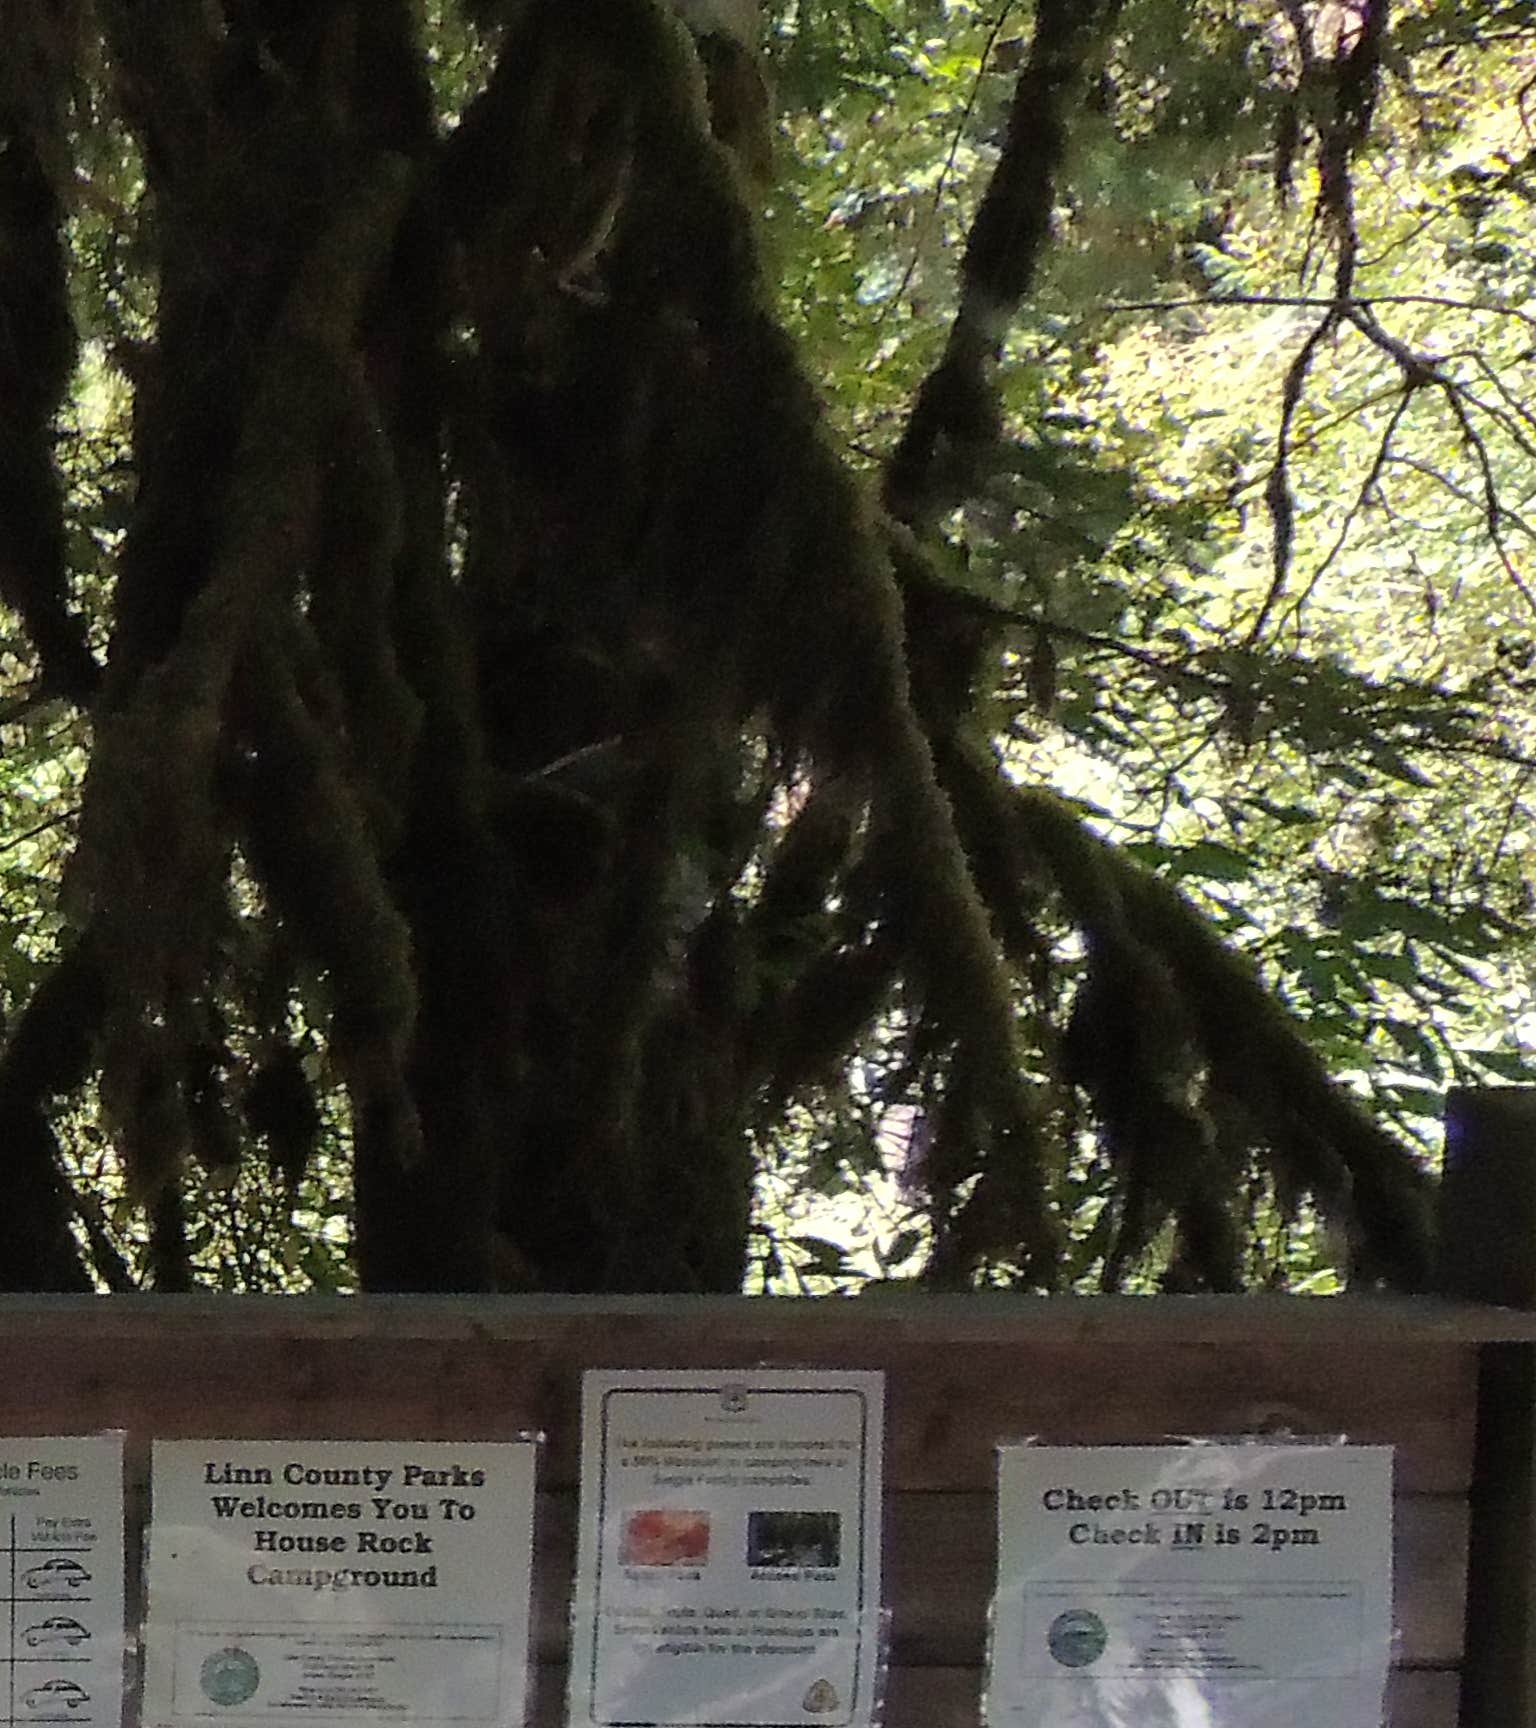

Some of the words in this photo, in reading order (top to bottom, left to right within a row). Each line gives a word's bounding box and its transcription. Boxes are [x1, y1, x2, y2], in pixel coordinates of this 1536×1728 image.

[28, 1463, 79, 1481] Fees
[204, 1463, 272, 1486] Linn
[284, 1464, 392, 1491] County
[404, 1465, 485, 1488] Parks
[210, 1497, 362, 1519] Welcomes
[371, 1499, 428, 1520] You
[440, 1500, 475, 1521] To
[1043, 1488, 1138, 1512] Check
[1151, 1490, 1212, 1513] OUT
[1222, 1488, 1248, 1511] is
[1262, 1490, 1347, 1516] 12pm
[254, 1531, 346, 1553] House
[358, 1532, 433, 1554] Rock
[1070, 1523, 1161, 1545] Check
[1171, 1523, 1204, 1545] IN
[1216, 1524, 1240, 1544] is
[1252, 1524, 1319, 1551] 2pm
[247, 1564, 438, 1592] Campground
